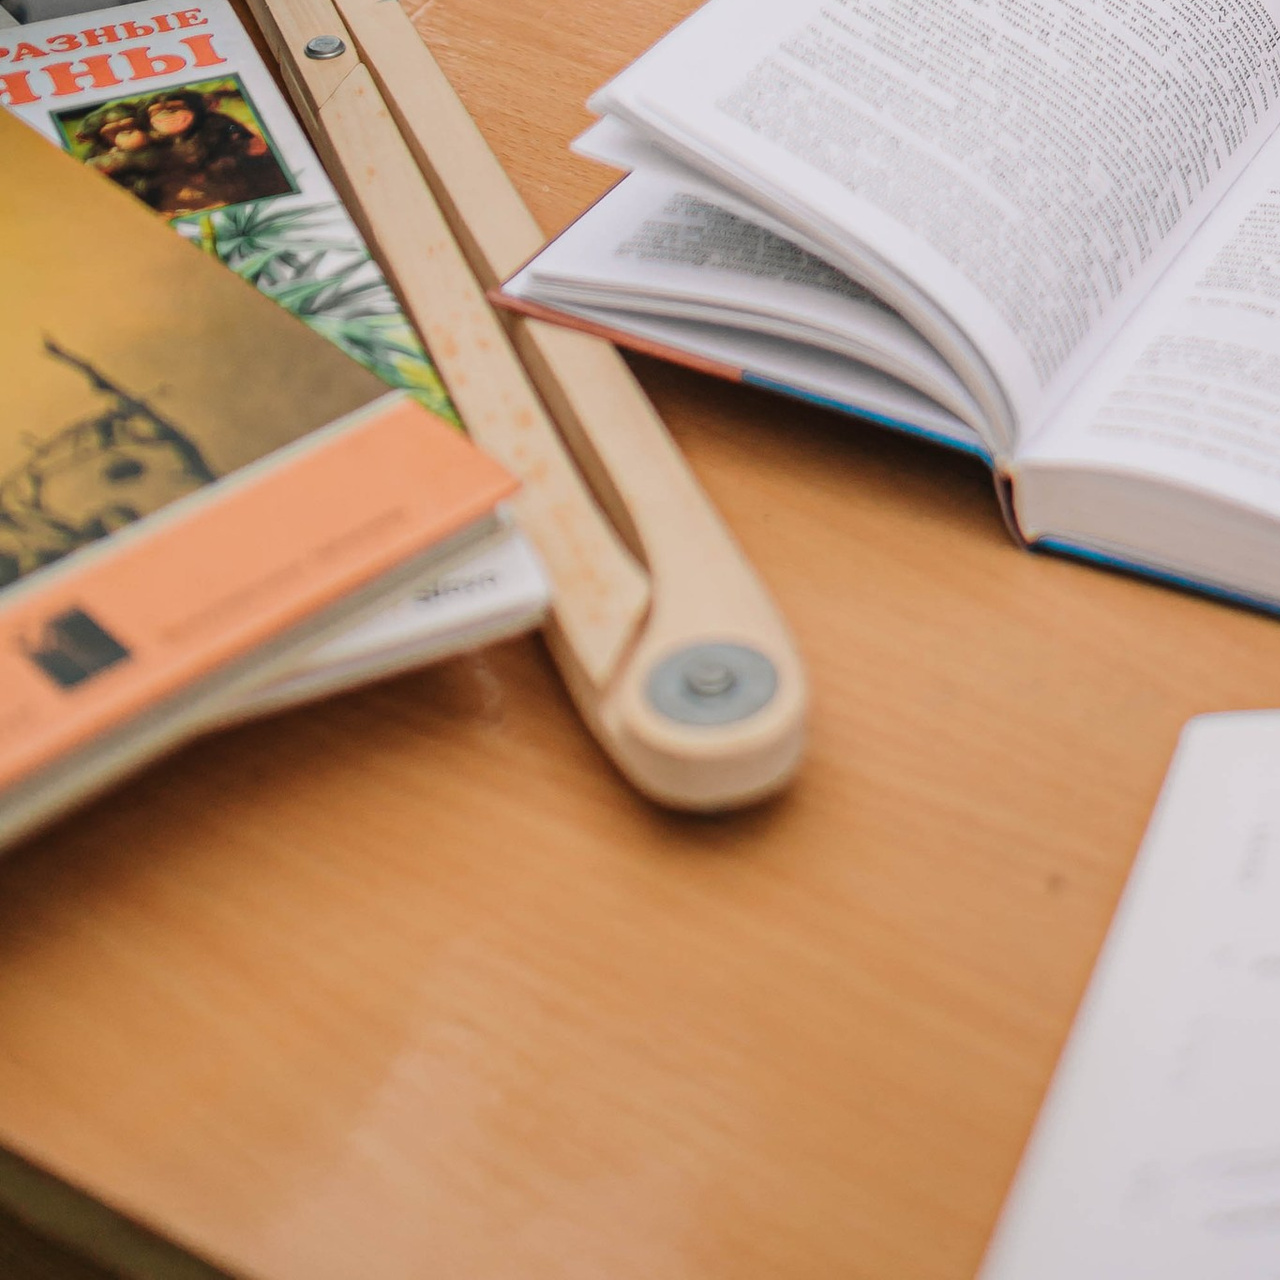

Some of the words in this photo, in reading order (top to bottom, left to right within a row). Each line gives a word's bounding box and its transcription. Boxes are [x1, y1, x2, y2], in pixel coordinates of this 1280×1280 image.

[1169, 1, 1206, 39] старая,
[1216, 27, 1232, 46] вас
[1238, 16, 1264, 54] миски
[1205, 38, 1228, 70] была
[1225, 27, 1261, 80] украсть?
[1231, 16, 1262, 69] Слушай,
[1266, 31, 1277, 49] Не
[1236, 55, 1252, 81] Вон
[1227, 69, 1248, 110] Байка
[1258, 81, 1270, 112] надо
